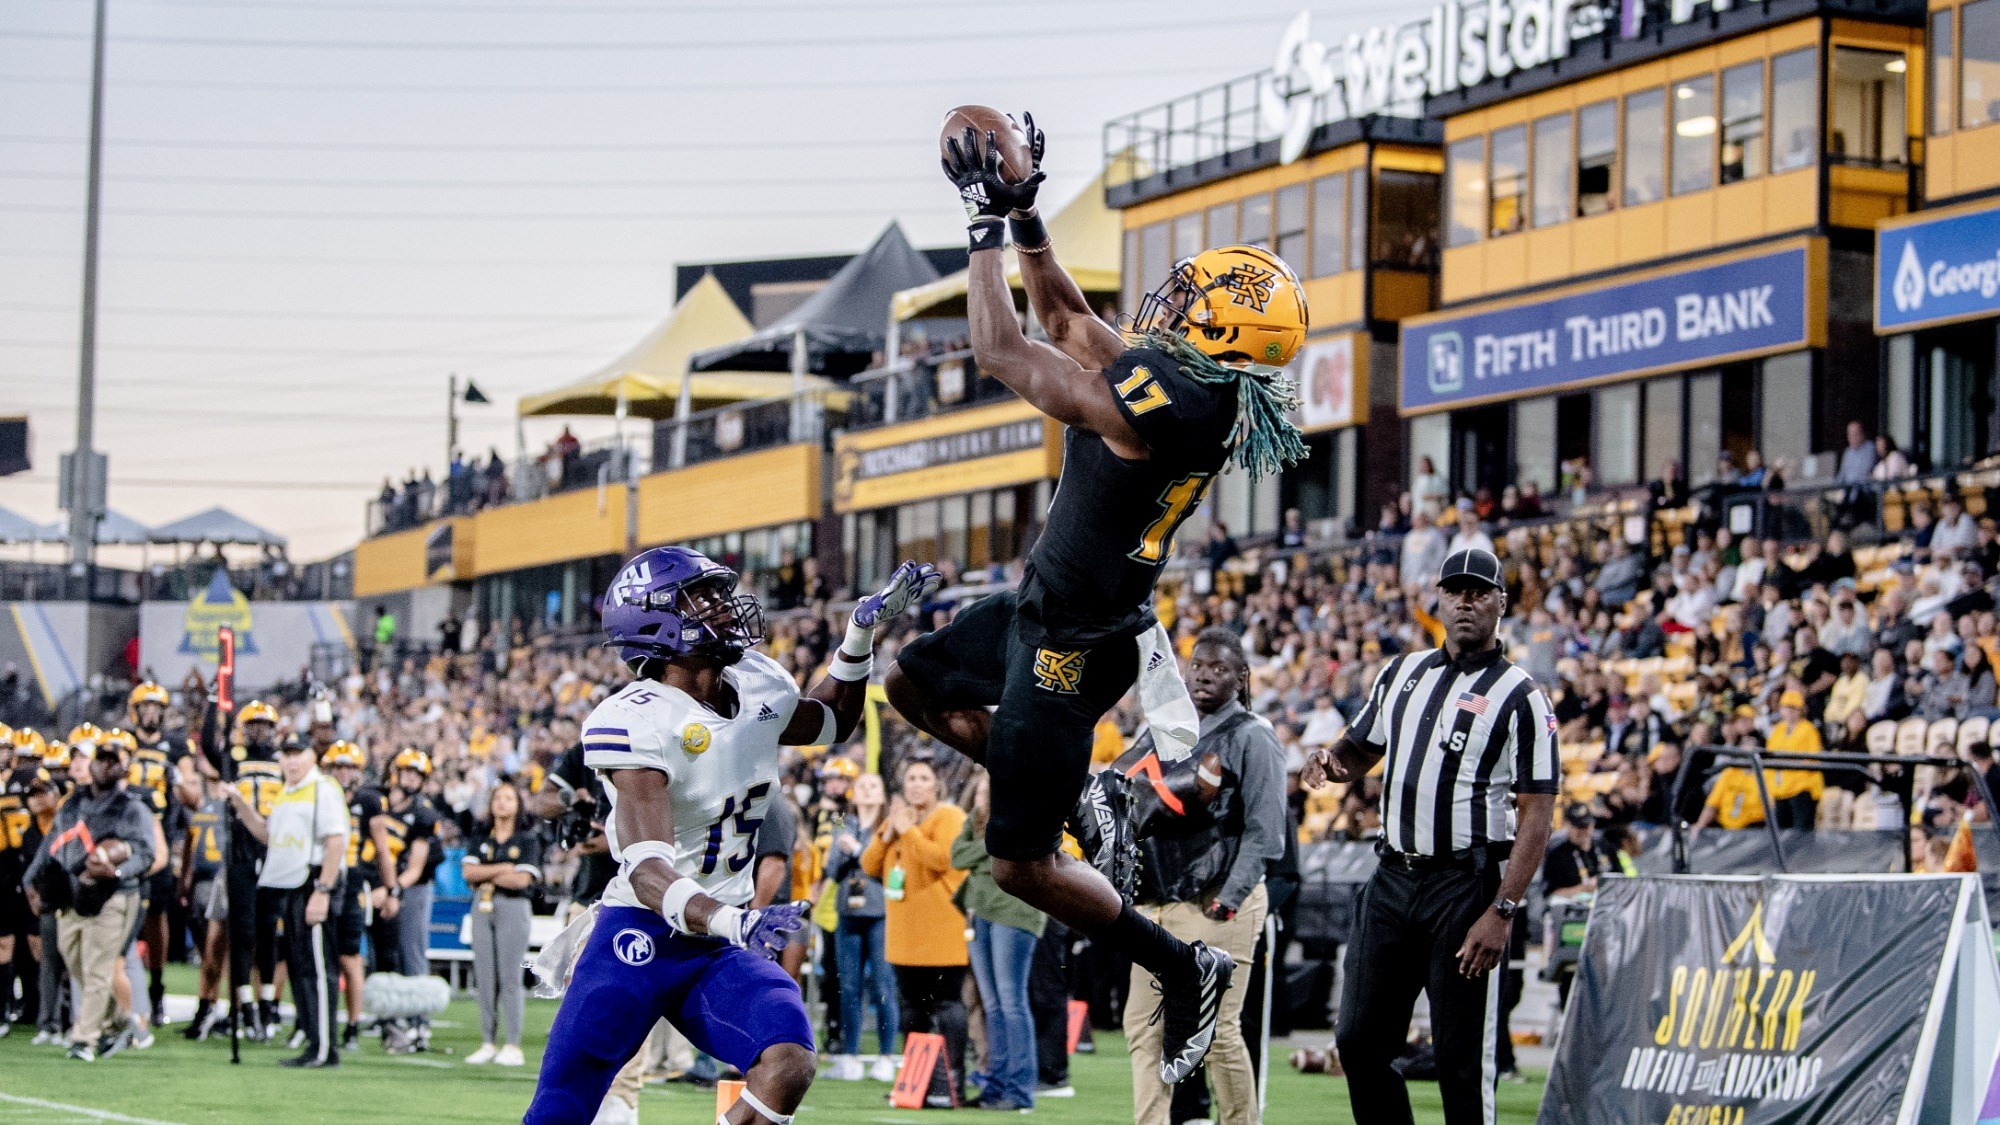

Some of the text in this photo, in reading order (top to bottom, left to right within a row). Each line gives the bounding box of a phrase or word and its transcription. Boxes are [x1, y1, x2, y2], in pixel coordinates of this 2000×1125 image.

[1342, 0, 1569, 116] Wellstar
[1473, 329, 1557, 380] FIFTH
[1565, 307, 1667, 362] THIRD
[1675, 284, 1774, 342] BANK
[1115, 364, 1173, 416] 17
[620, 688, 661, 705] 15
[1402, 679, 1418, 693] S
[1449, 730, 1468, 752] S
[698, 778, 772, 878] 15
